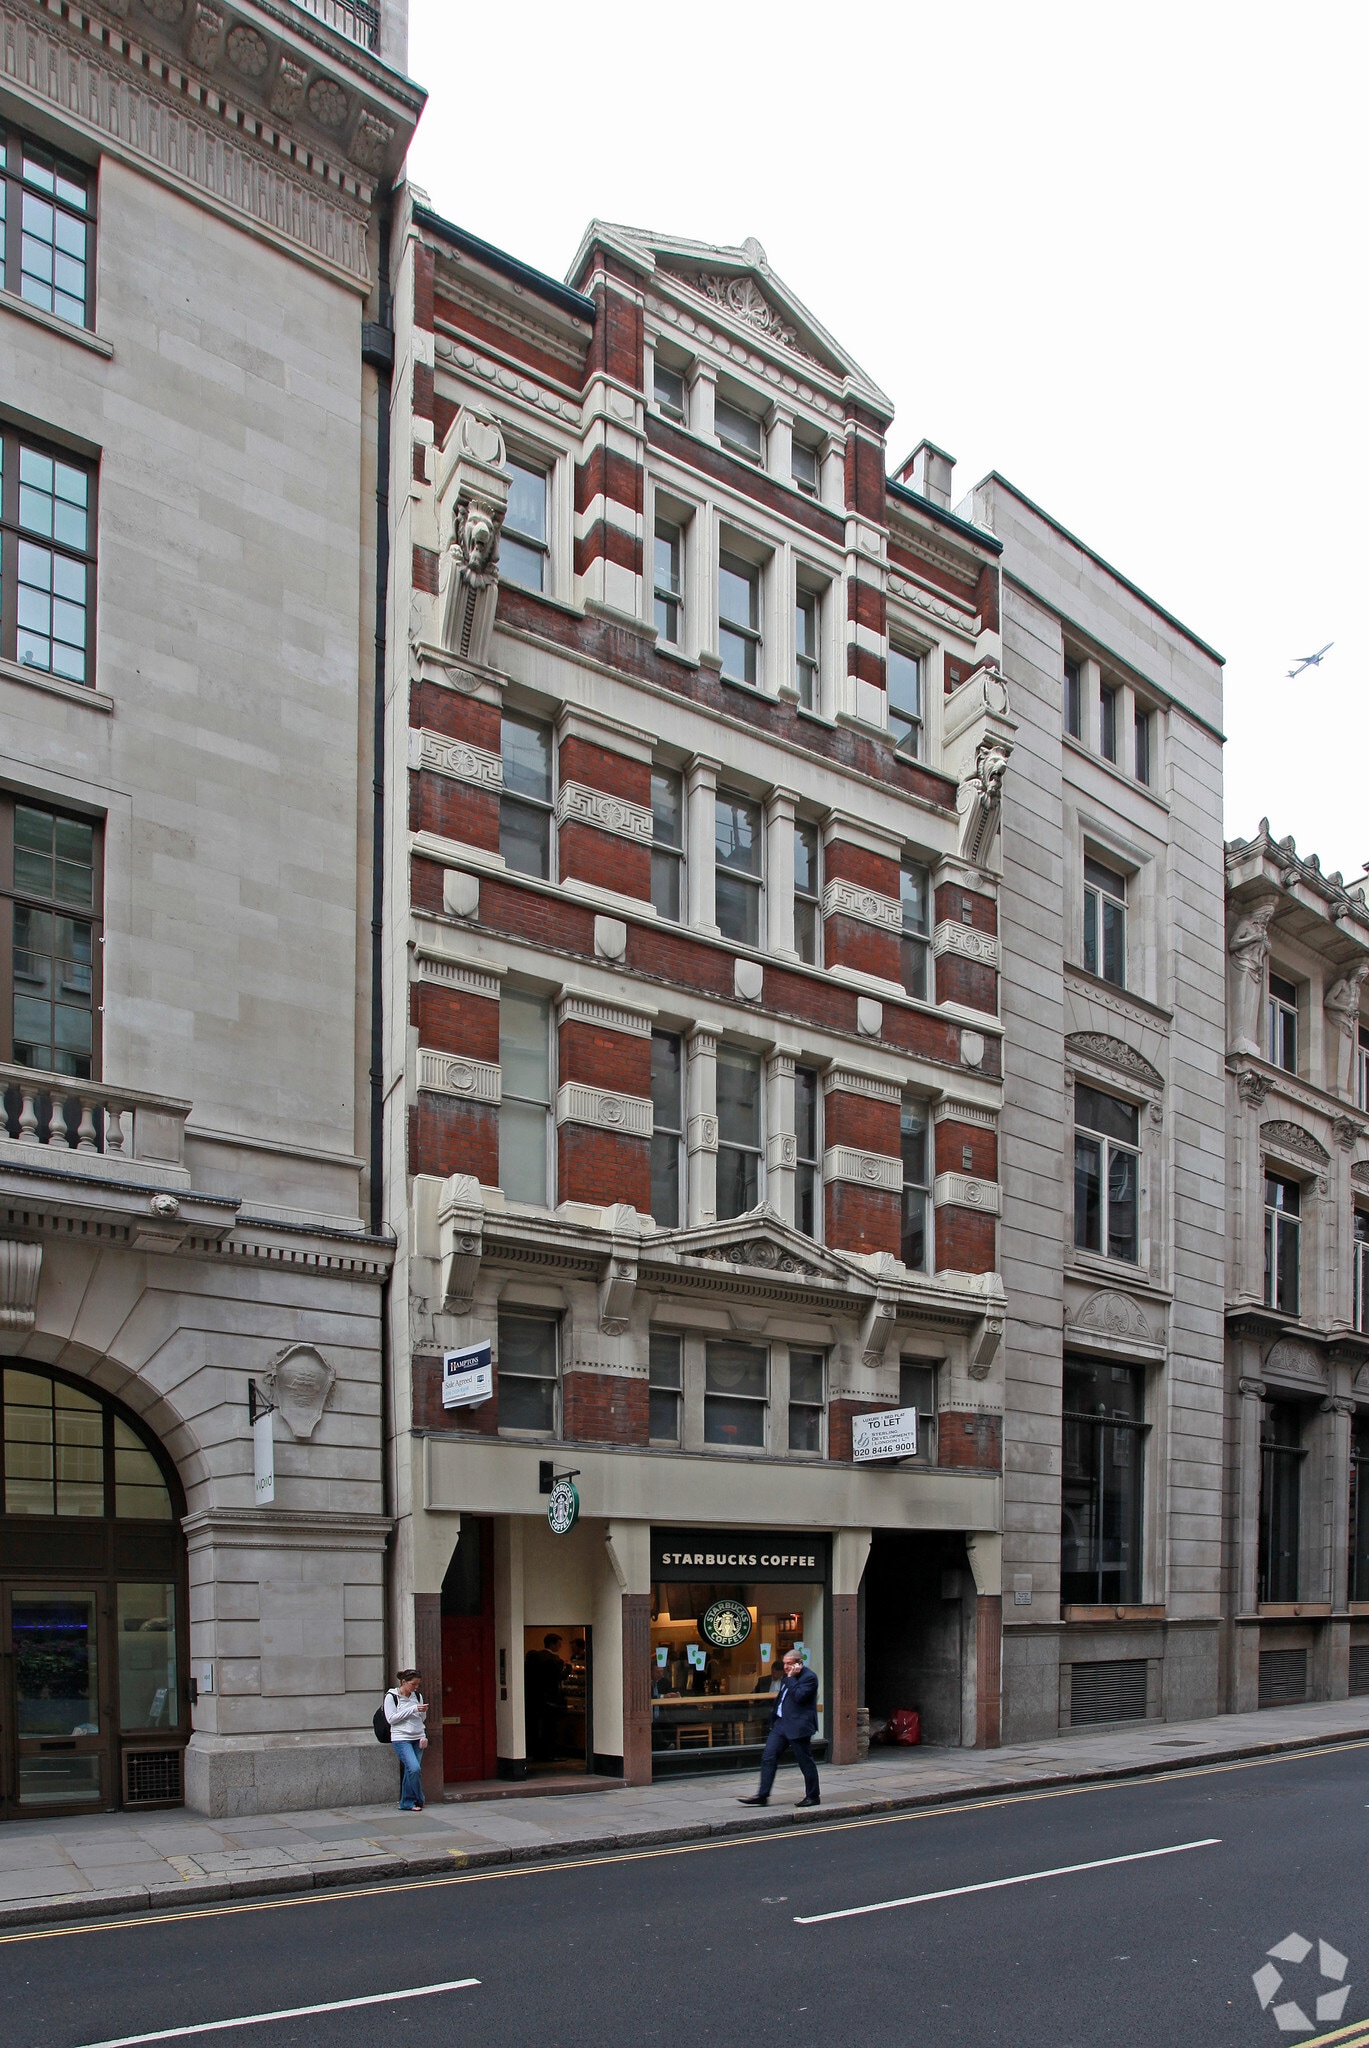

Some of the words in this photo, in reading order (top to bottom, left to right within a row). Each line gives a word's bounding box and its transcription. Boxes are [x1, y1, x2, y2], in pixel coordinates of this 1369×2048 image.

[450, 1356, 479, 1372] HAMPTONS
[868, 1420, 880, 1429] TO
[883, 1417, 901, 1427] LET
[871, 1429, 898, 1437] STERLING
[871, 1432, 914, 1442] DEVELOPMENTS
[854, 1448, 870, 1457] 020
[872, 1445, 893, 1455] 8446
[895, 1442, 915, 1452] 9001
[549, 1484, 573, 1507] STARBUCKS
[551, 1517, 570, 1531] COFFEE
[662, 1553, 757, 1566] STARBUCKS
[760, 1555, 815, 1567] COFFEE
[706, 1602, 749, 1623] STARBUCKS
[710, 1631, 744, 1645] COFFEE
